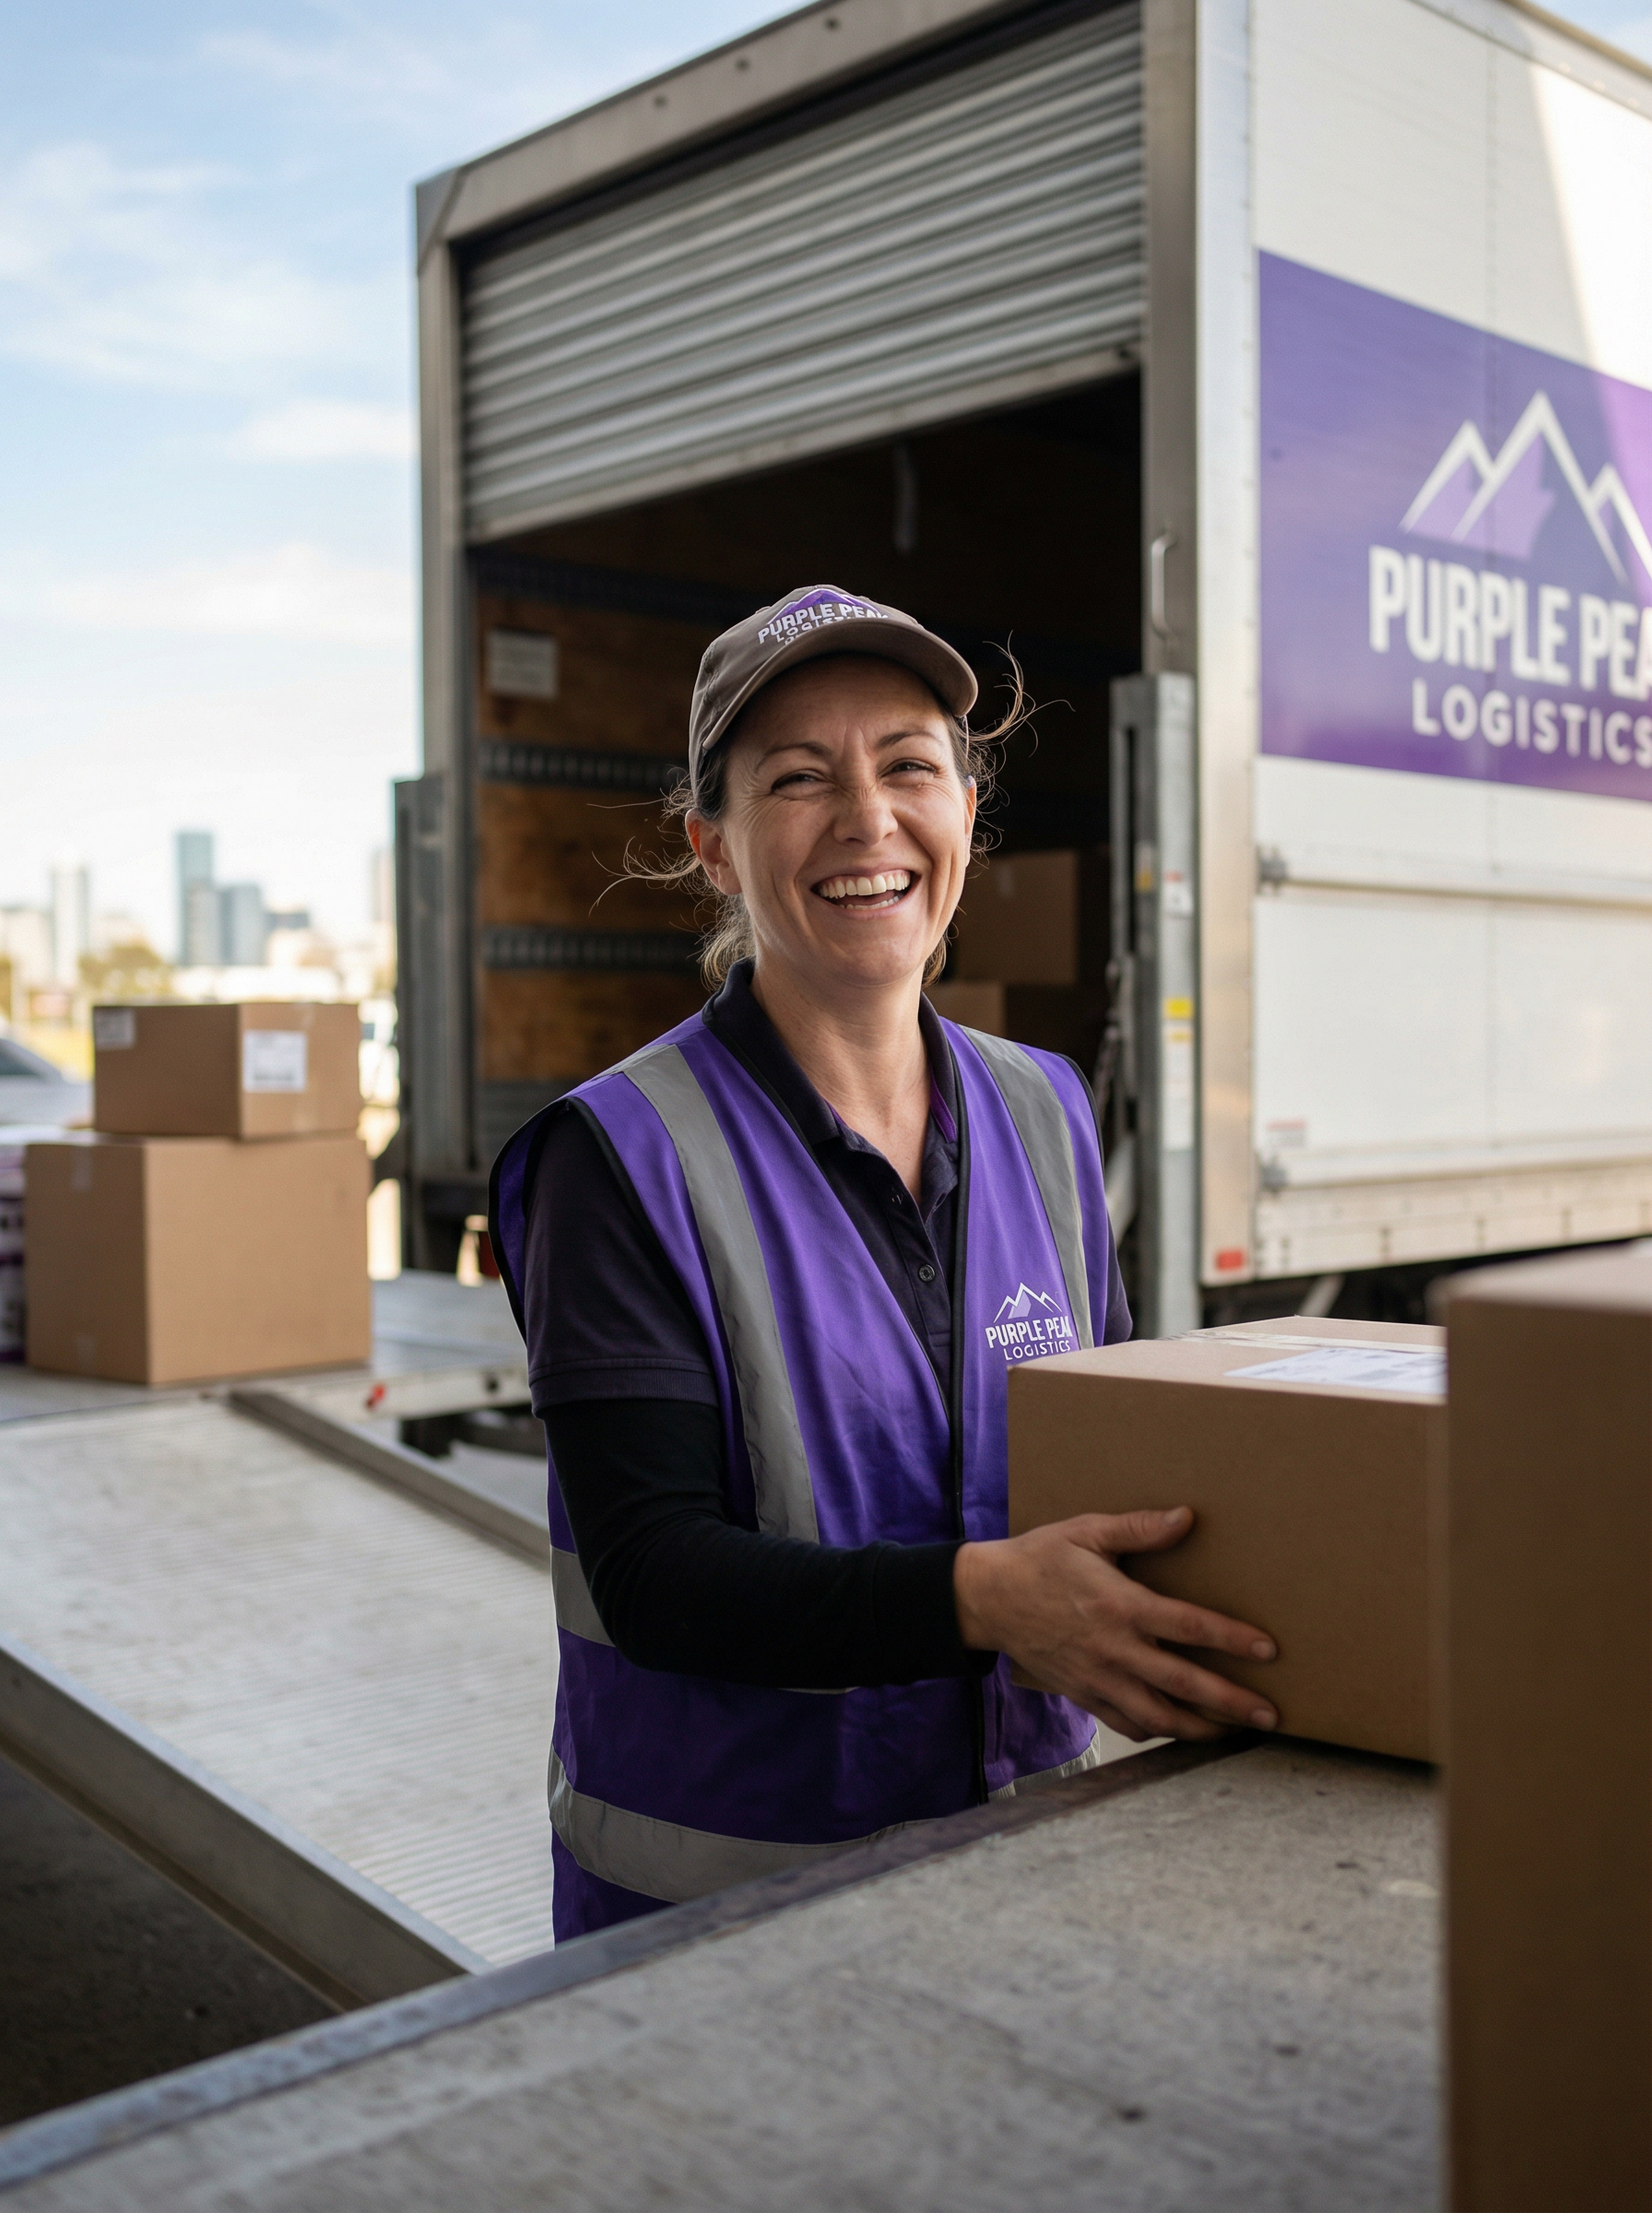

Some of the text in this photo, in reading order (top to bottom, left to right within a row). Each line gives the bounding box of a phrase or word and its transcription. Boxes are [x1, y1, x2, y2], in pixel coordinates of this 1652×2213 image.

[758, 603, 835, 644] PURPLE
[1369, 545, 1570, 685] PURPLE
[1413, 677, 1652, 769] LOGISTICS
[985, 1320, 1045, 1348] PURPLE
[1003, 1340, 1070, 1360] LOGISTICS
